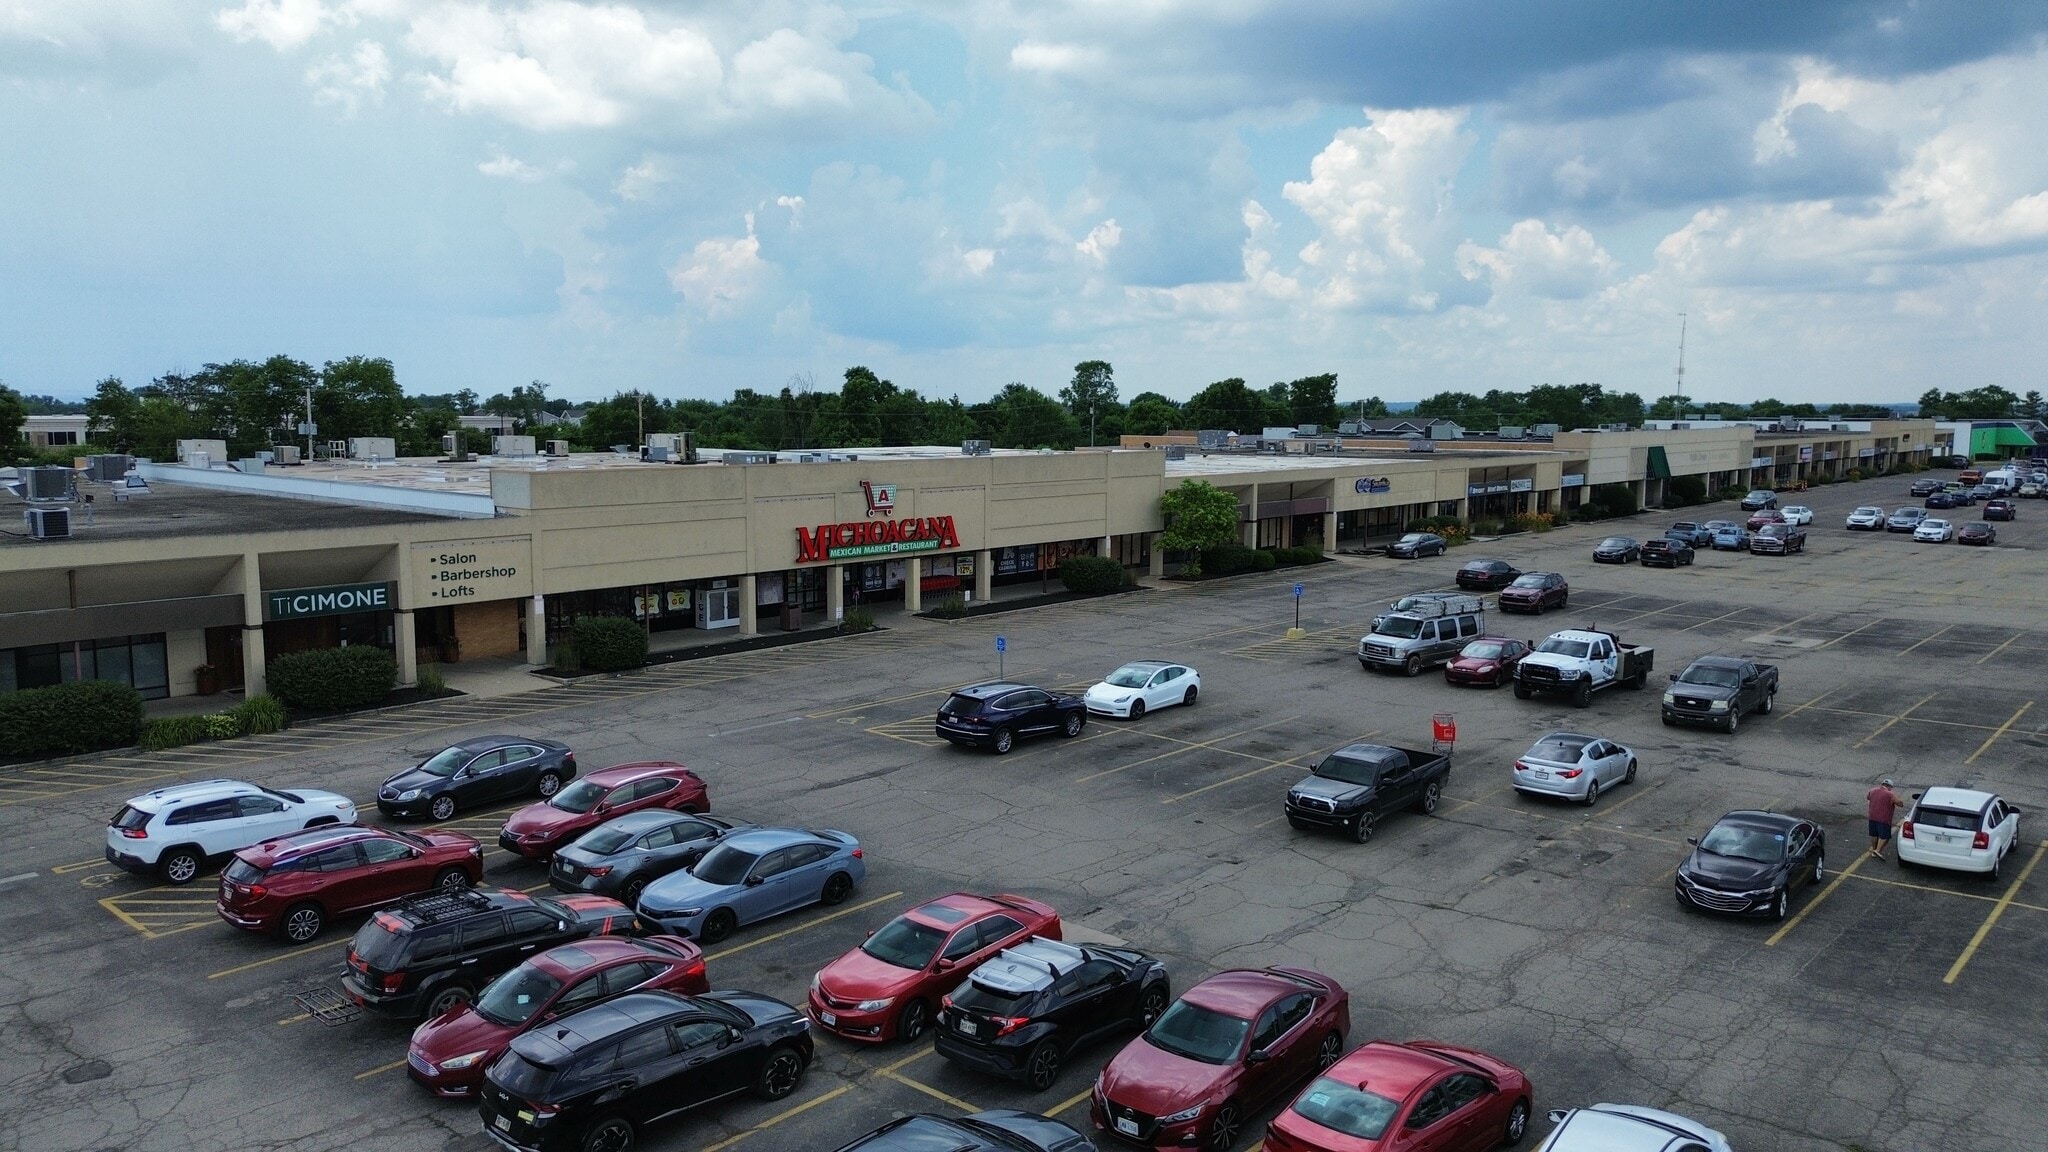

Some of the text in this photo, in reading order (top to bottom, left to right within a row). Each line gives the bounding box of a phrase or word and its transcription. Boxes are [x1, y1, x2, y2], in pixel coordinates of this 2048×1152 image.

[878, 489, 889, 502] A
[796, 515, 960, 563] MICHOACANA
[830, 547, 862, 558] MEXICAN
[863, 543, 891, 554] MARKET
[898, 540, 938, 551] RESTAURANT
[440, 553, 476, 565] Salon
[441, 566, 516, 581] Barbershop
[442, 585, 475, 598] Lofts
